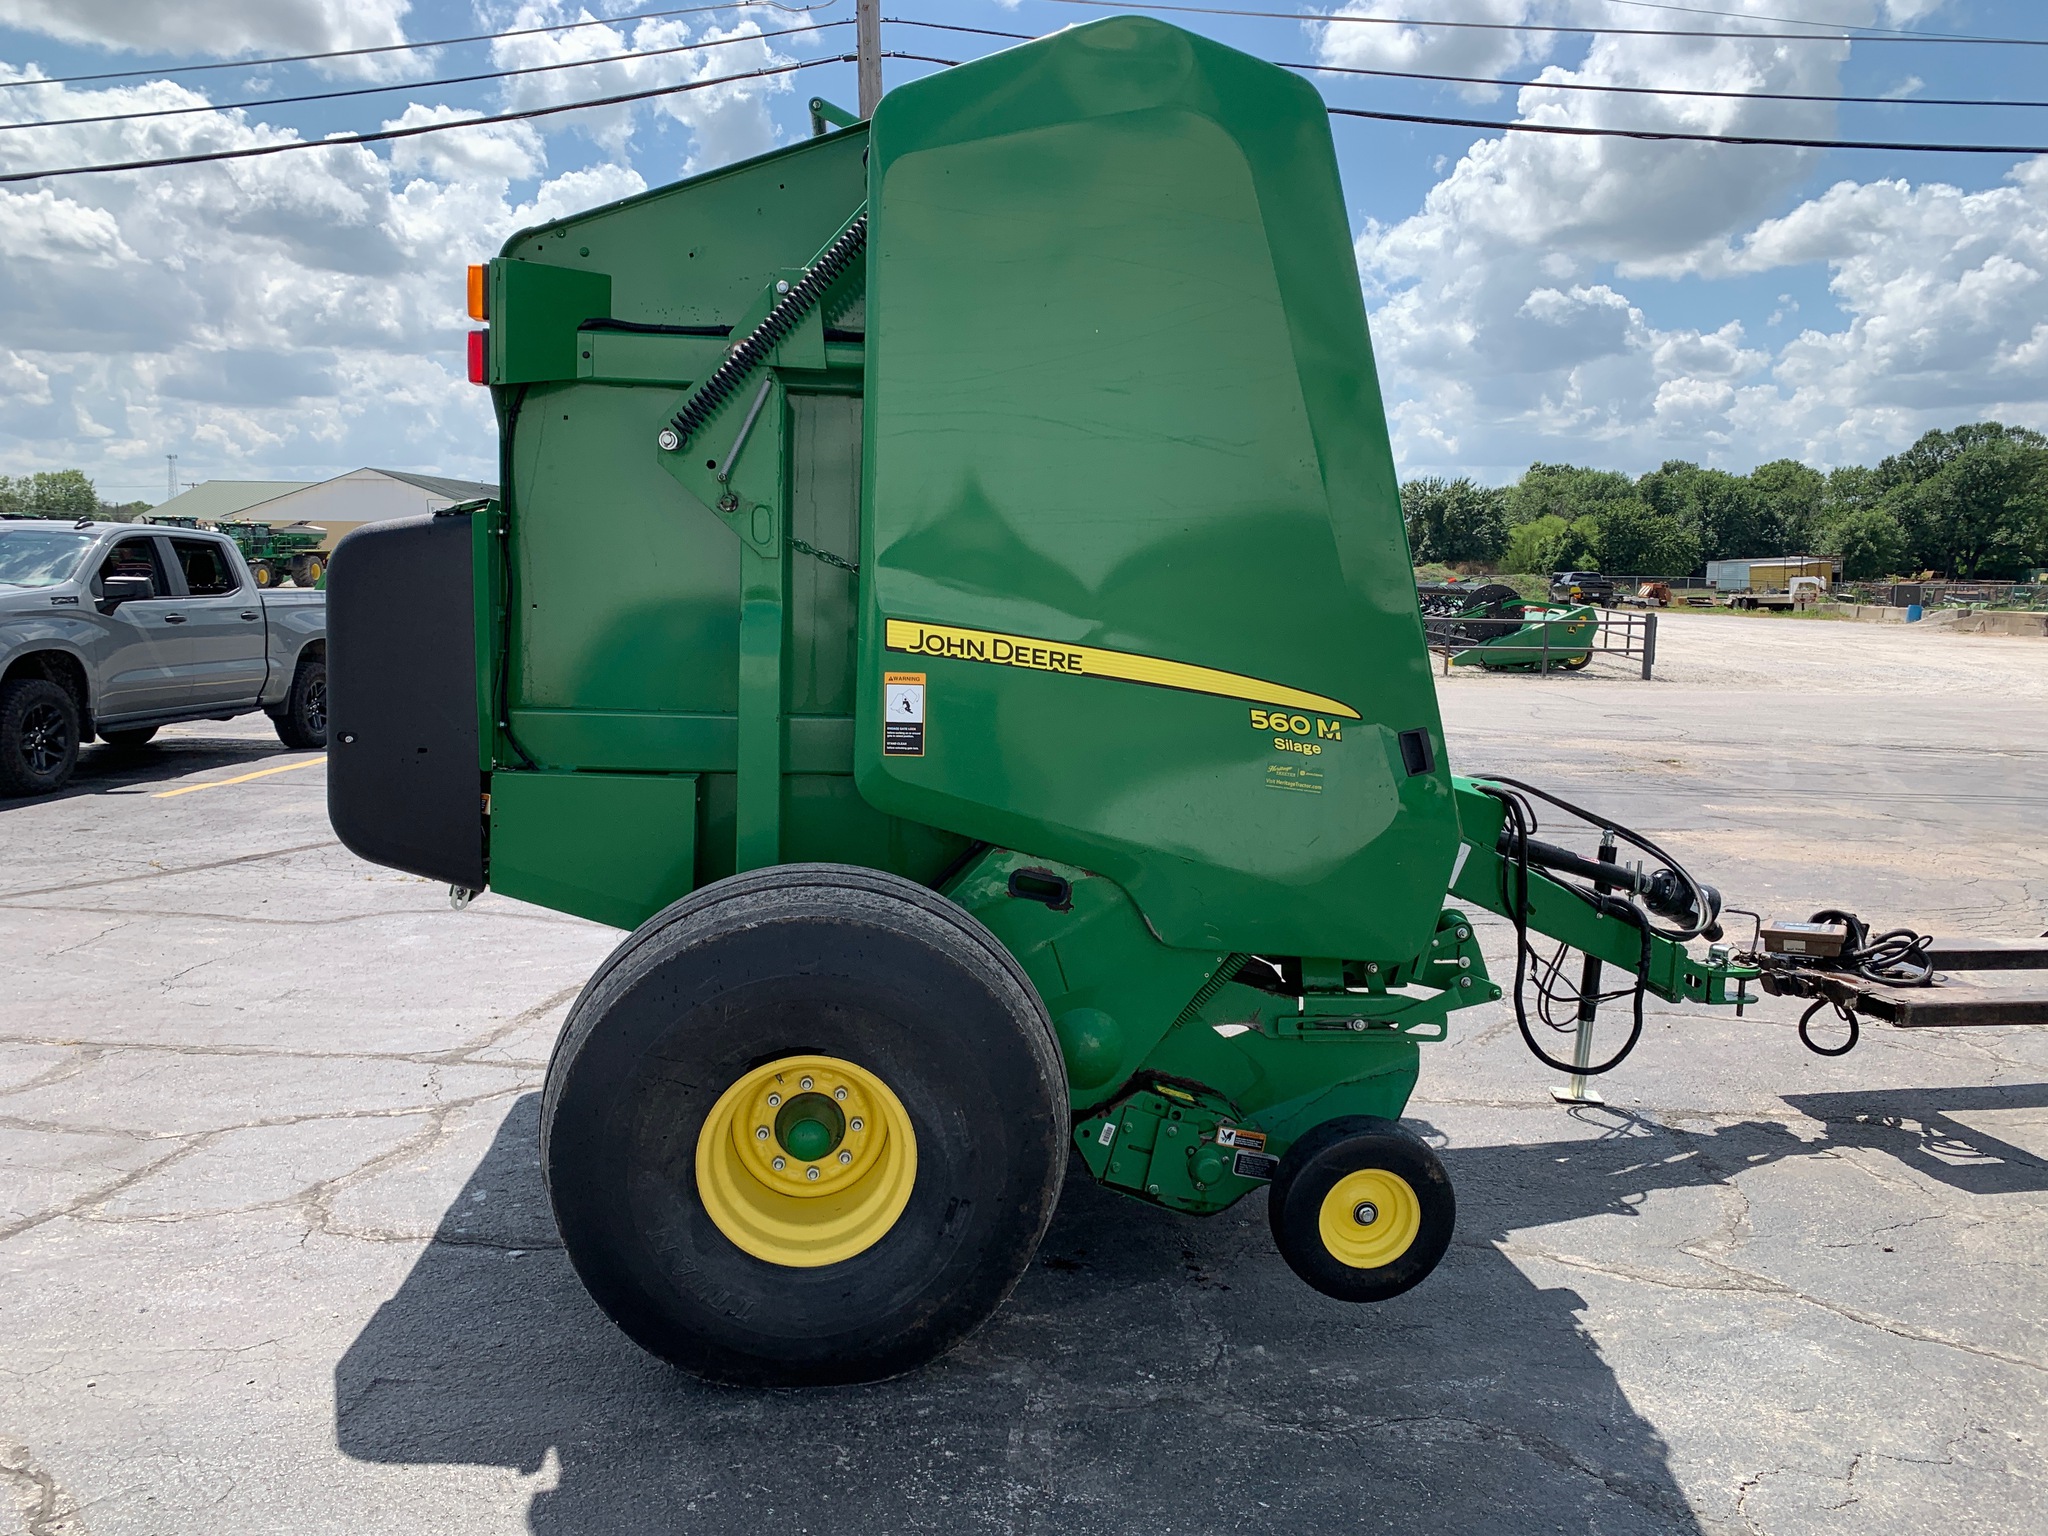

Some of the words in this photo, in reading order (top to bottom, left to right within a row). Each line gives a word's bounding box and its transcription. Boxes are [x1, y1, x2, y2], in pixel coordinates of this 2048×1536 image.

[909, 629, 985, 658] JOHN
[993, 638, 1083, 672] DEERE
[1250, 708, 1312, 736] 560
[1316, 717, 1342, 742] M
[1273, 737, 1322, 756] Silage
